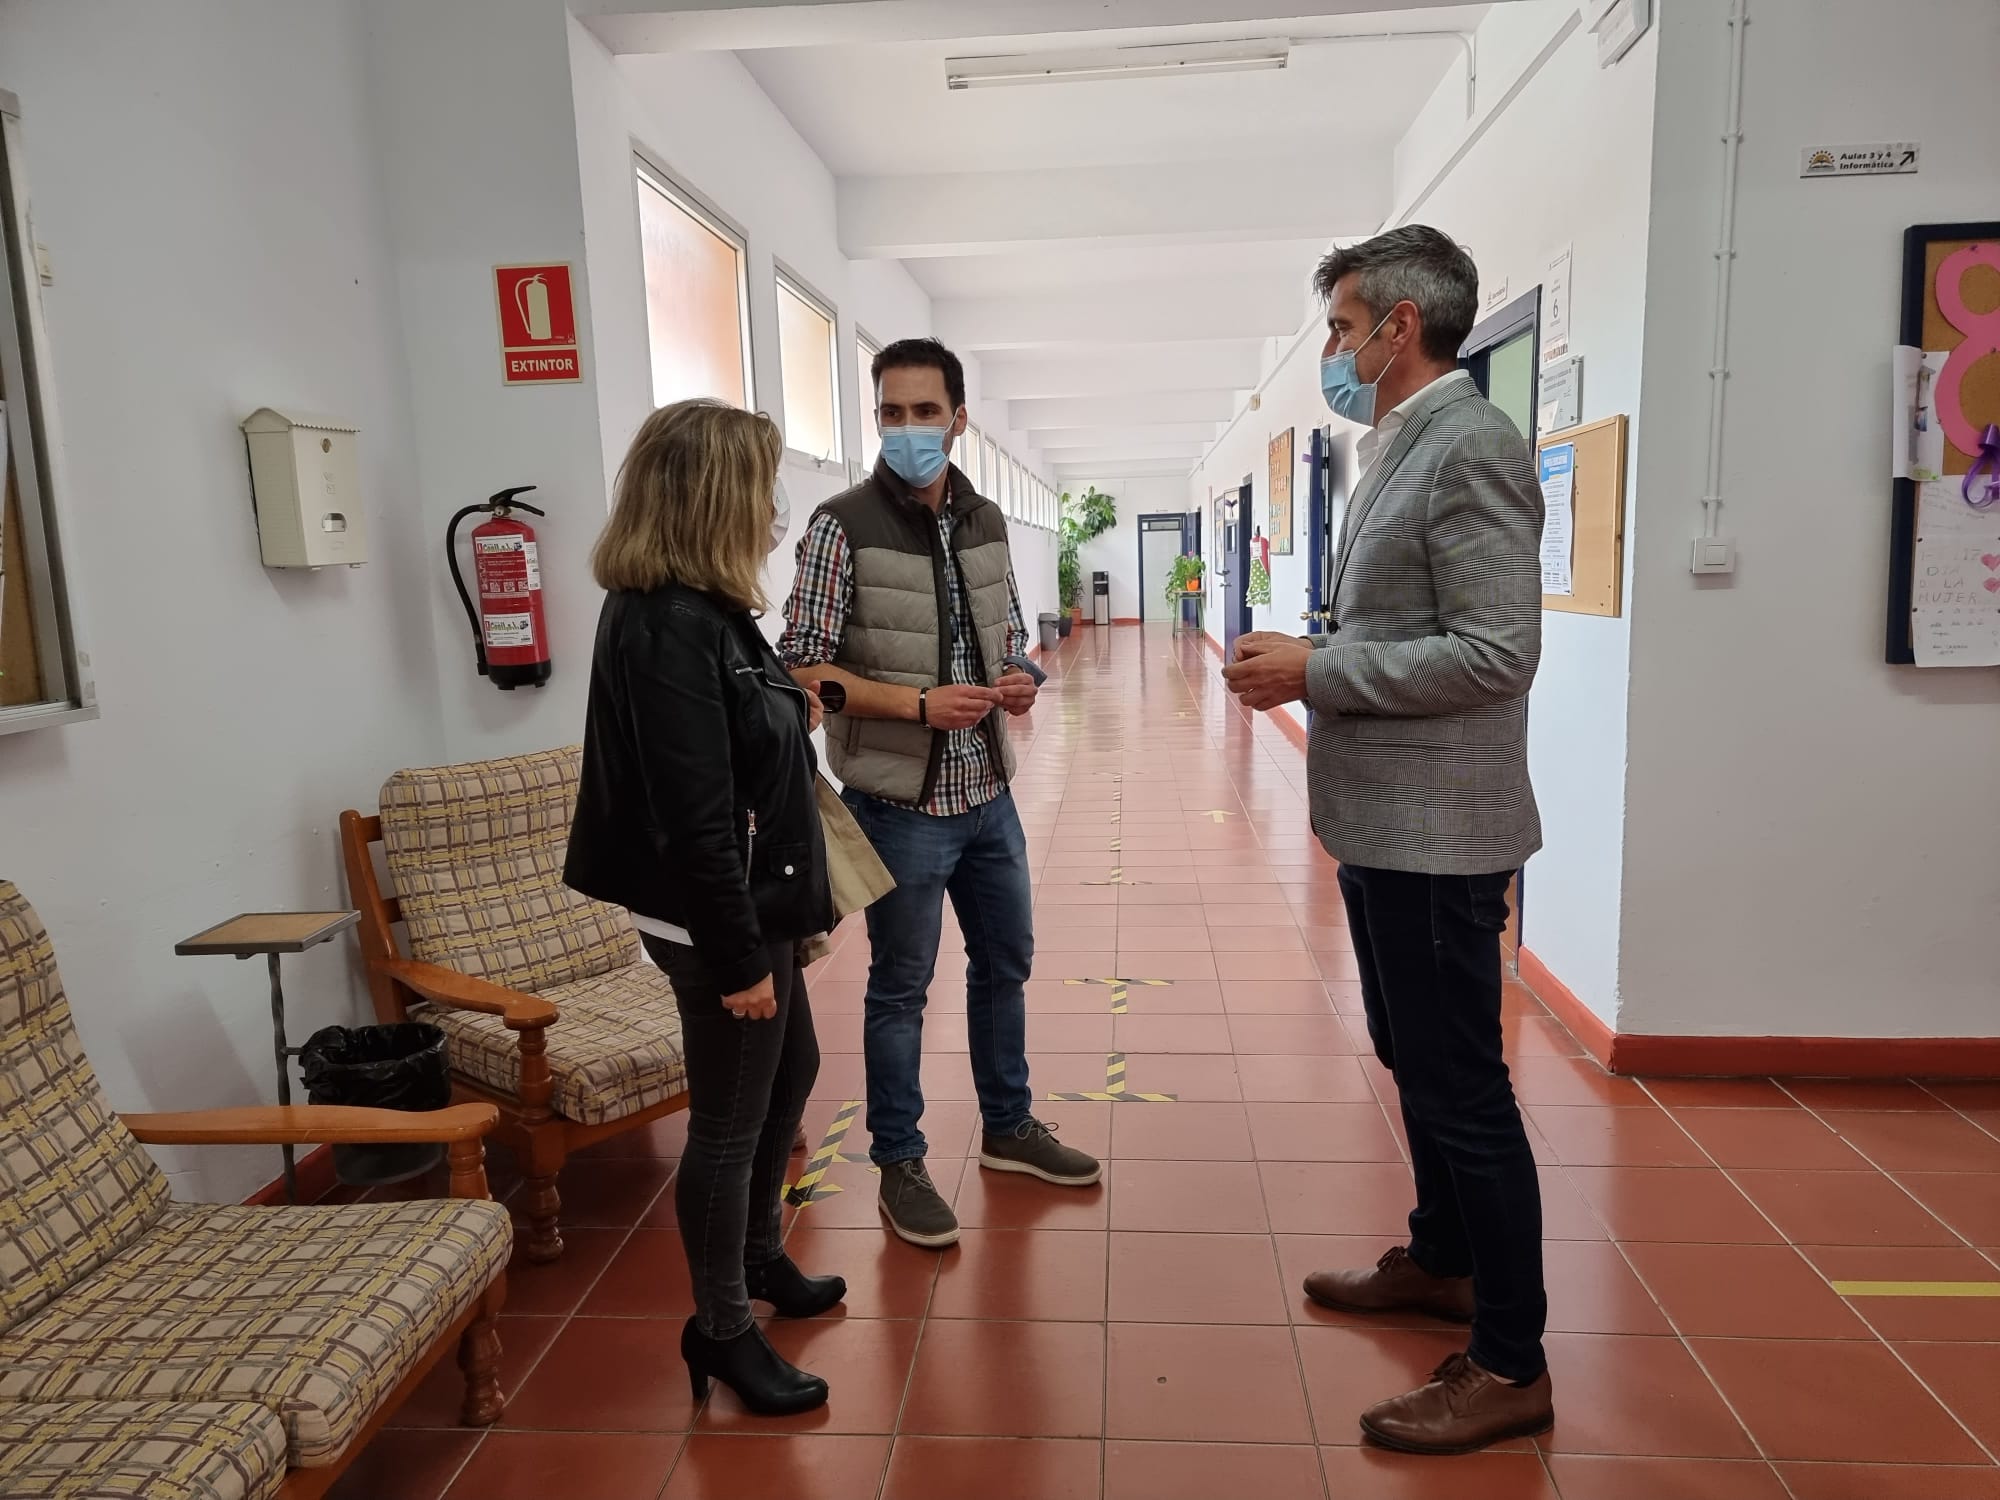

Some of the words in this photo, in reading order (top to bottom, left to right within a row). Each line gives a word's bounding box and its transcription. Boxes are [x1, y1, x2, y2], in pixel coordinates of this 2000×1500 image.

[1840, 161, 1894, 169] Informática
[1552, 297, 1559, 319] 6
[511, 359, 574, 372] EXTINTOR
[1919, 592, 1977, 605] MUJER
